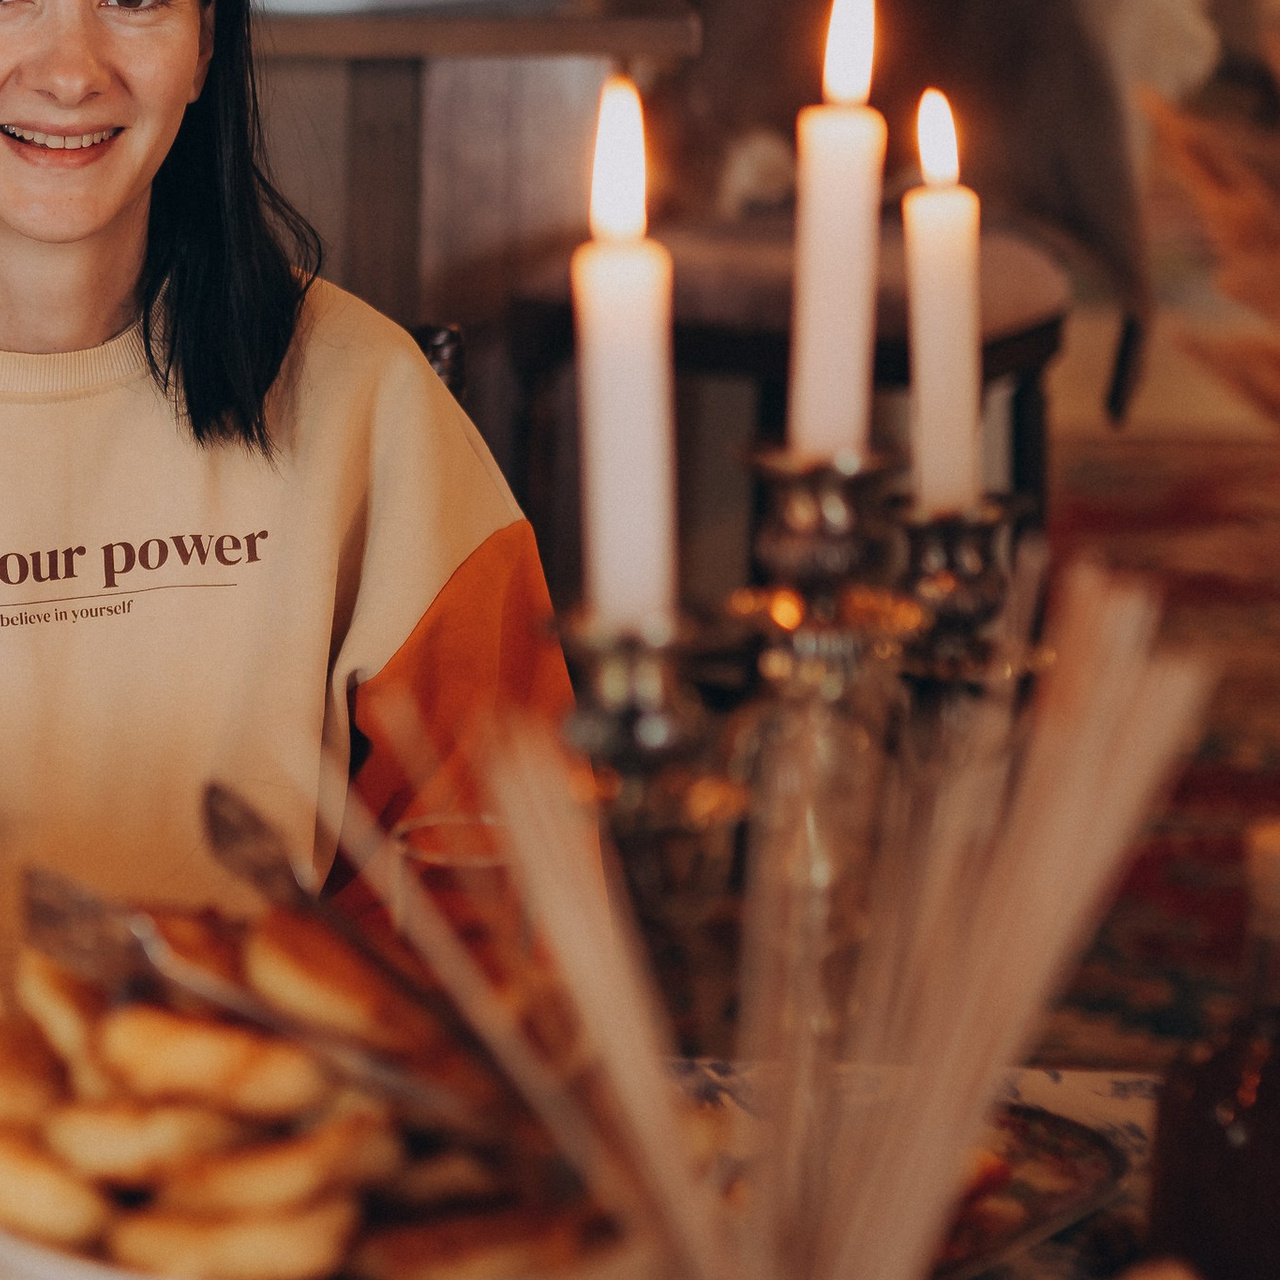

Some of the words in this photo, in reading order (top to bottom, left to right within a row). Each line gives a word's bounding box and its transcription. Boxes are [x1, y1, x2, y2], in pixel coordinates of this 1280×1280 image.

[100, 529, 269, 588] power
[0, 608, 51, 627] believe
[54, 607, 68, 622] in
[71, 599, 135, 624] yourself
